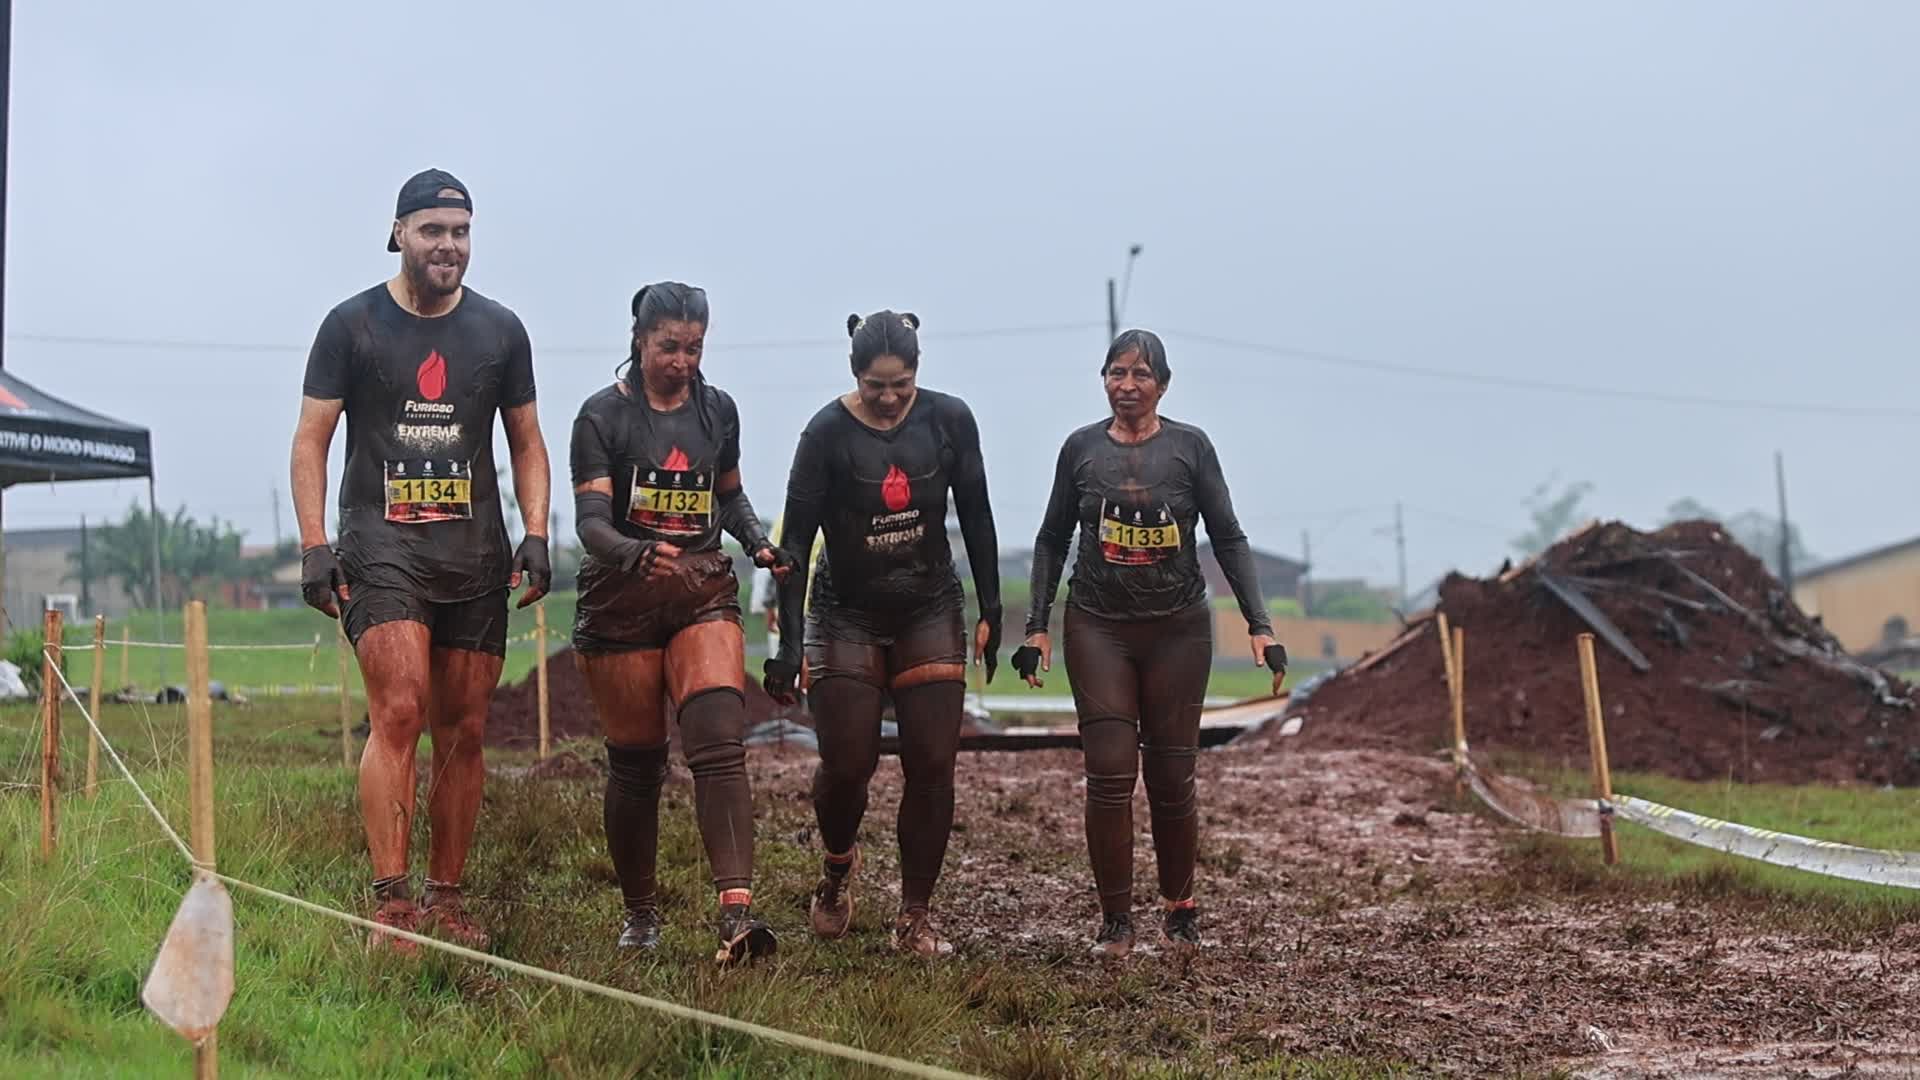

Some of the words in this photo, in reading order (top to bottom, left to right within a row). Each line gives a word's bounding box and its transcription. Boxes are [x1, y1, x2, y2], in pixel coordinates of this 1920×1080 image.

[404, 400, 455, 414] FURIOSO
[397, 423, 461, 442] EXTREMA
[402, 480, 457, 501] 1134
[650, 491, 700, 512] 1132
[1116, 525, 1165, 546] 1133
